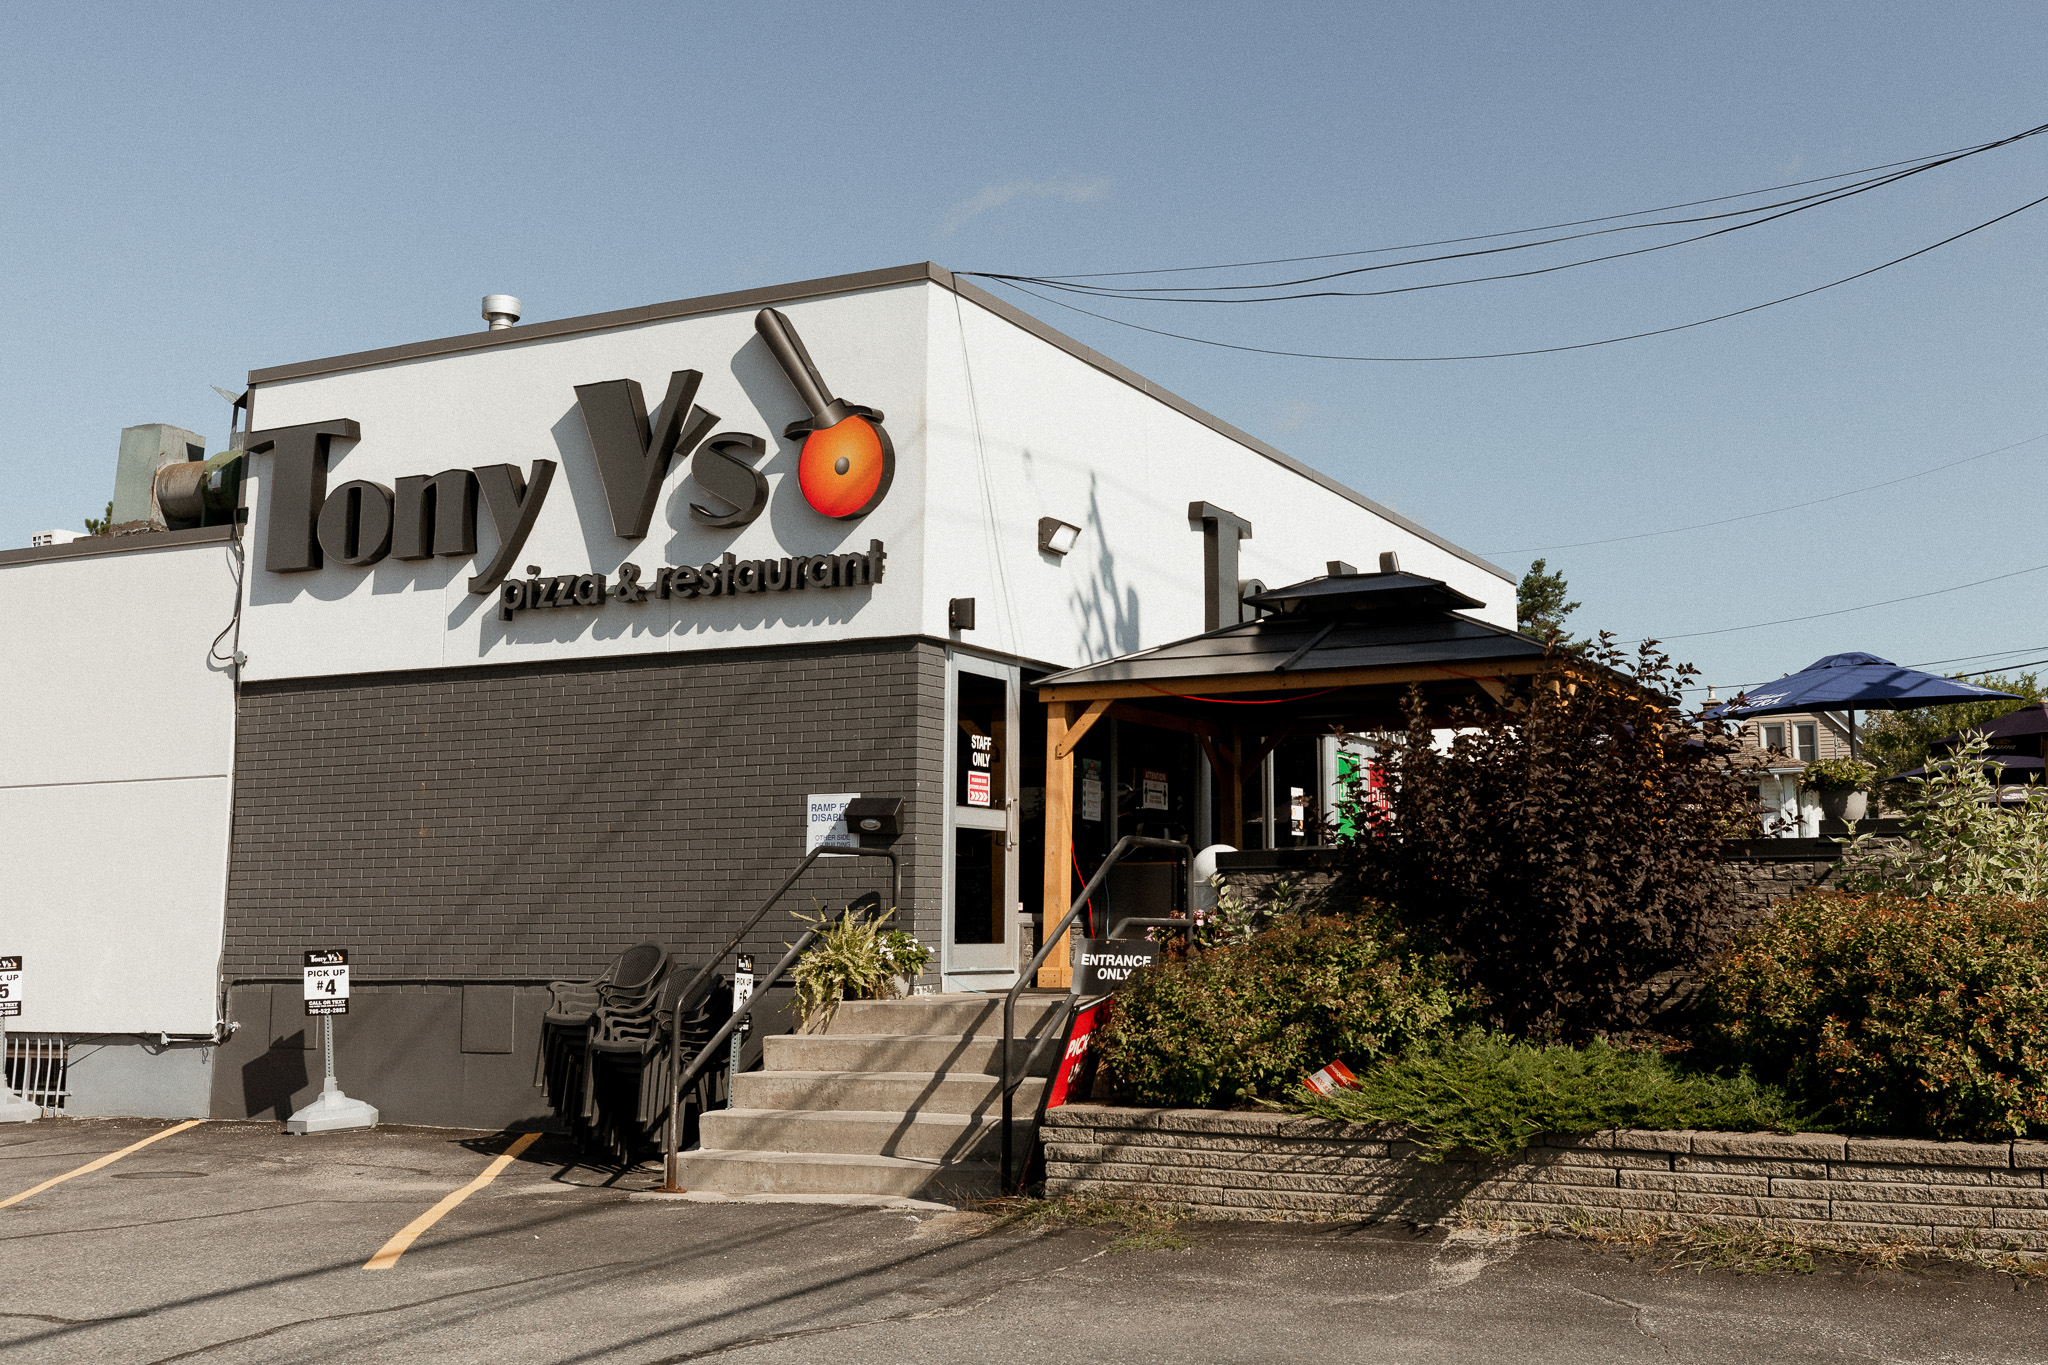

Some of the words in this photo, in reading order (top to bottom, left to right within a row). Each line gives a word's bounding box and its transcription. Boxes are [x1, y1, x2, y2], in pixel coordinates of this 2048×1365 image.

[246, 418, 557, 595] Tony
[574, 369, 769, 538] V's
[499, 564, 606, 621] pizza
[615, 562, 647, 602] &
[656, 538, 887, 599] restaurant
[971, 734, 991, 750] STAFF
[972, 752, 990, 767] ONLY
[811, 803, 837, 812] RAMP
[1081, 952, 1152, 968] ENTRANCE
[1097, 967, 1133, 981] ONLY
[317, 979, 336, 995] #4
